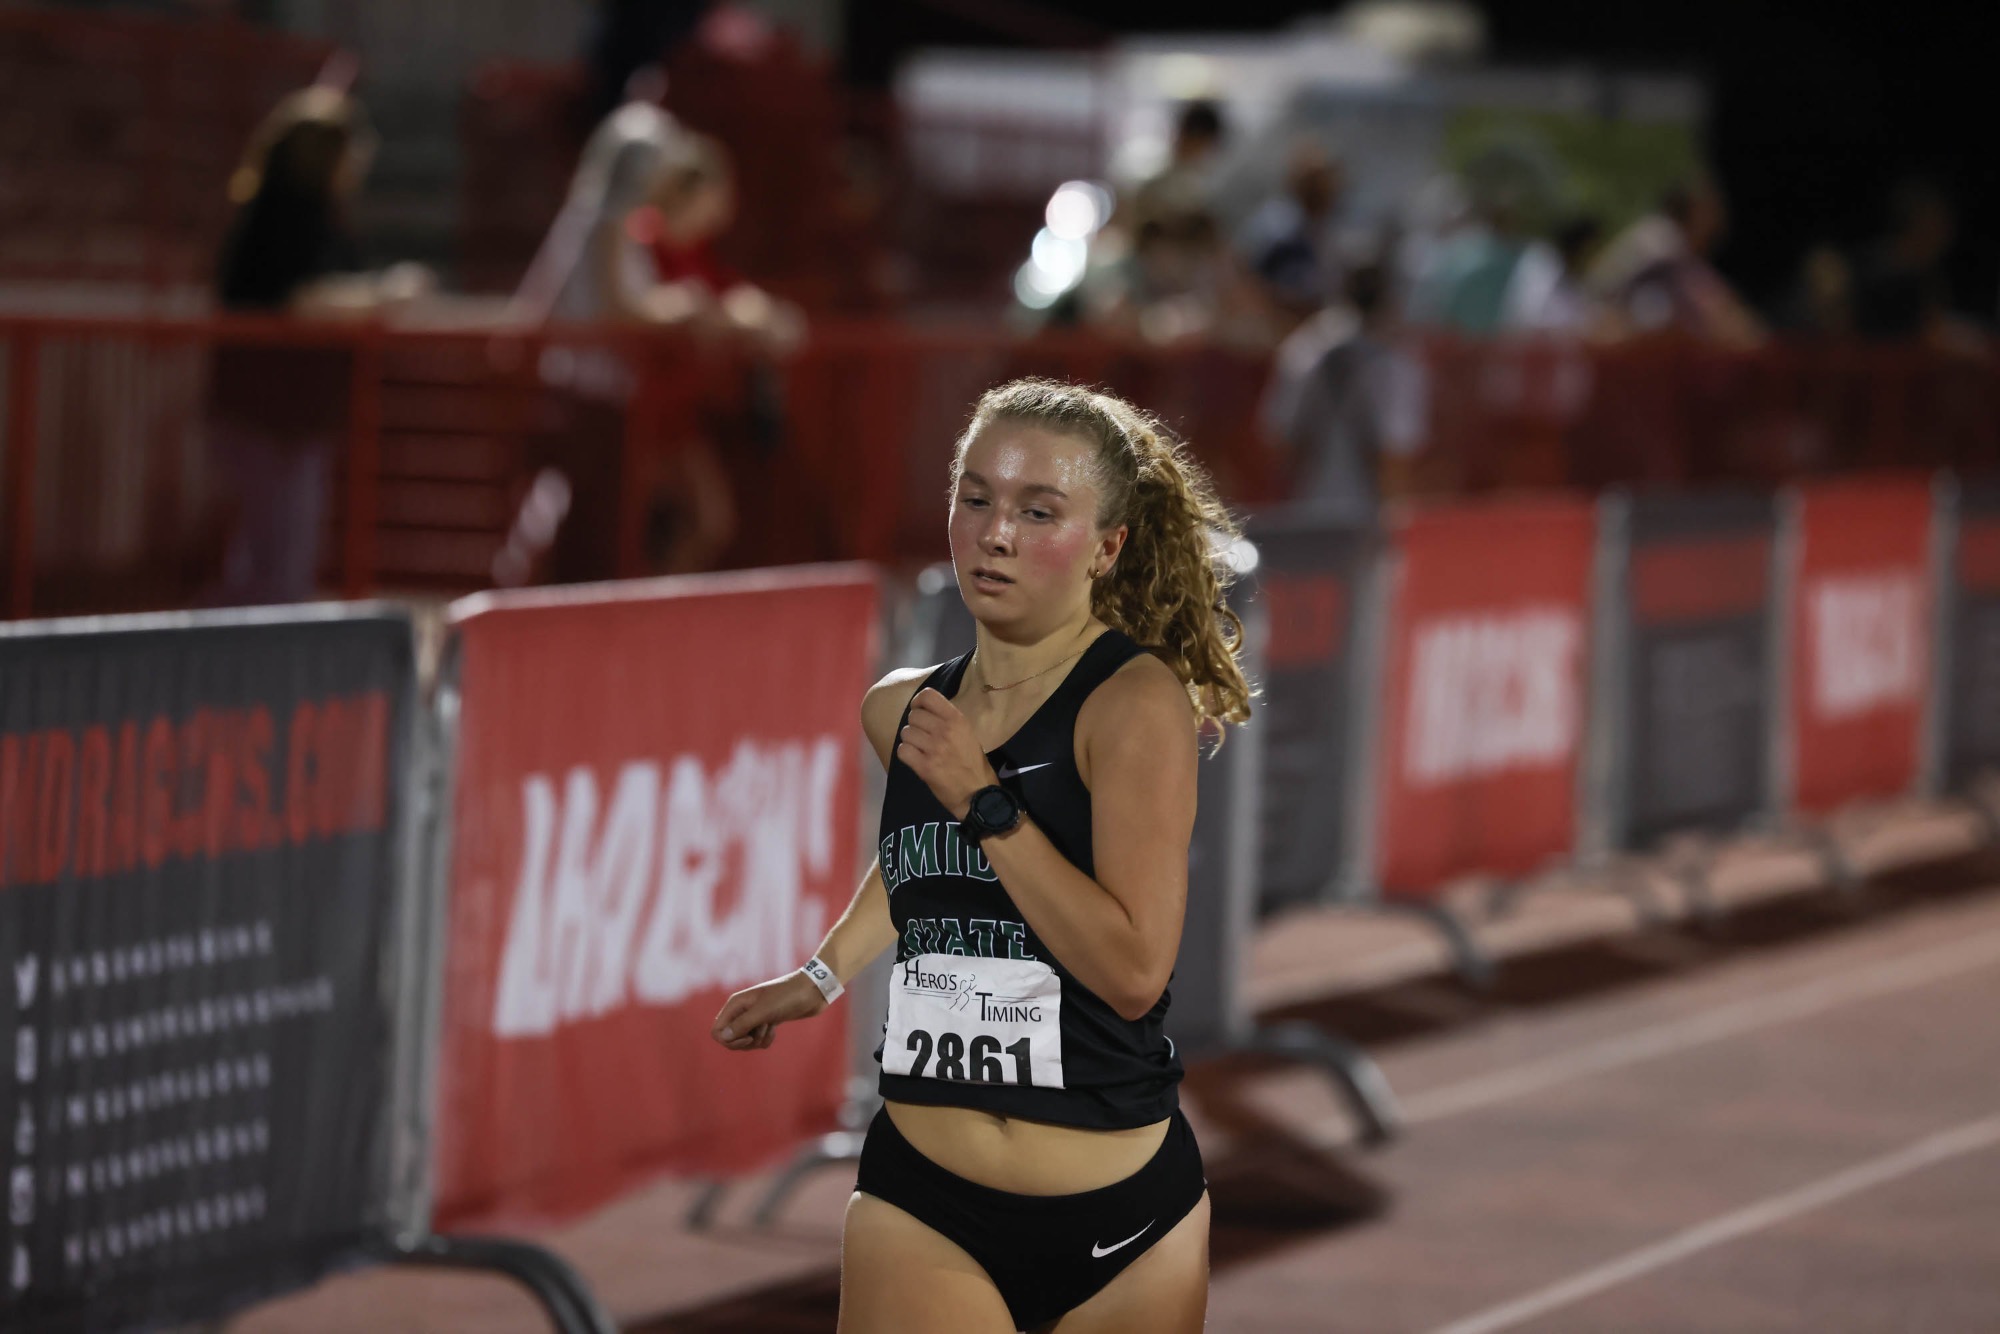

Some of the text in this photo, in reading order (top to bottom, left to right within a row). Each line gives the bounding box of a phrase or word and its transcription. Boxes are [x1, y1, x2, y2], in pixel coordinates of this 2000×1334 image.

[904, 918, 1037, 961] STATE
[975, 991, 1042, 1023] TIMING
[906, 1029, 1033, 1086] 2861
